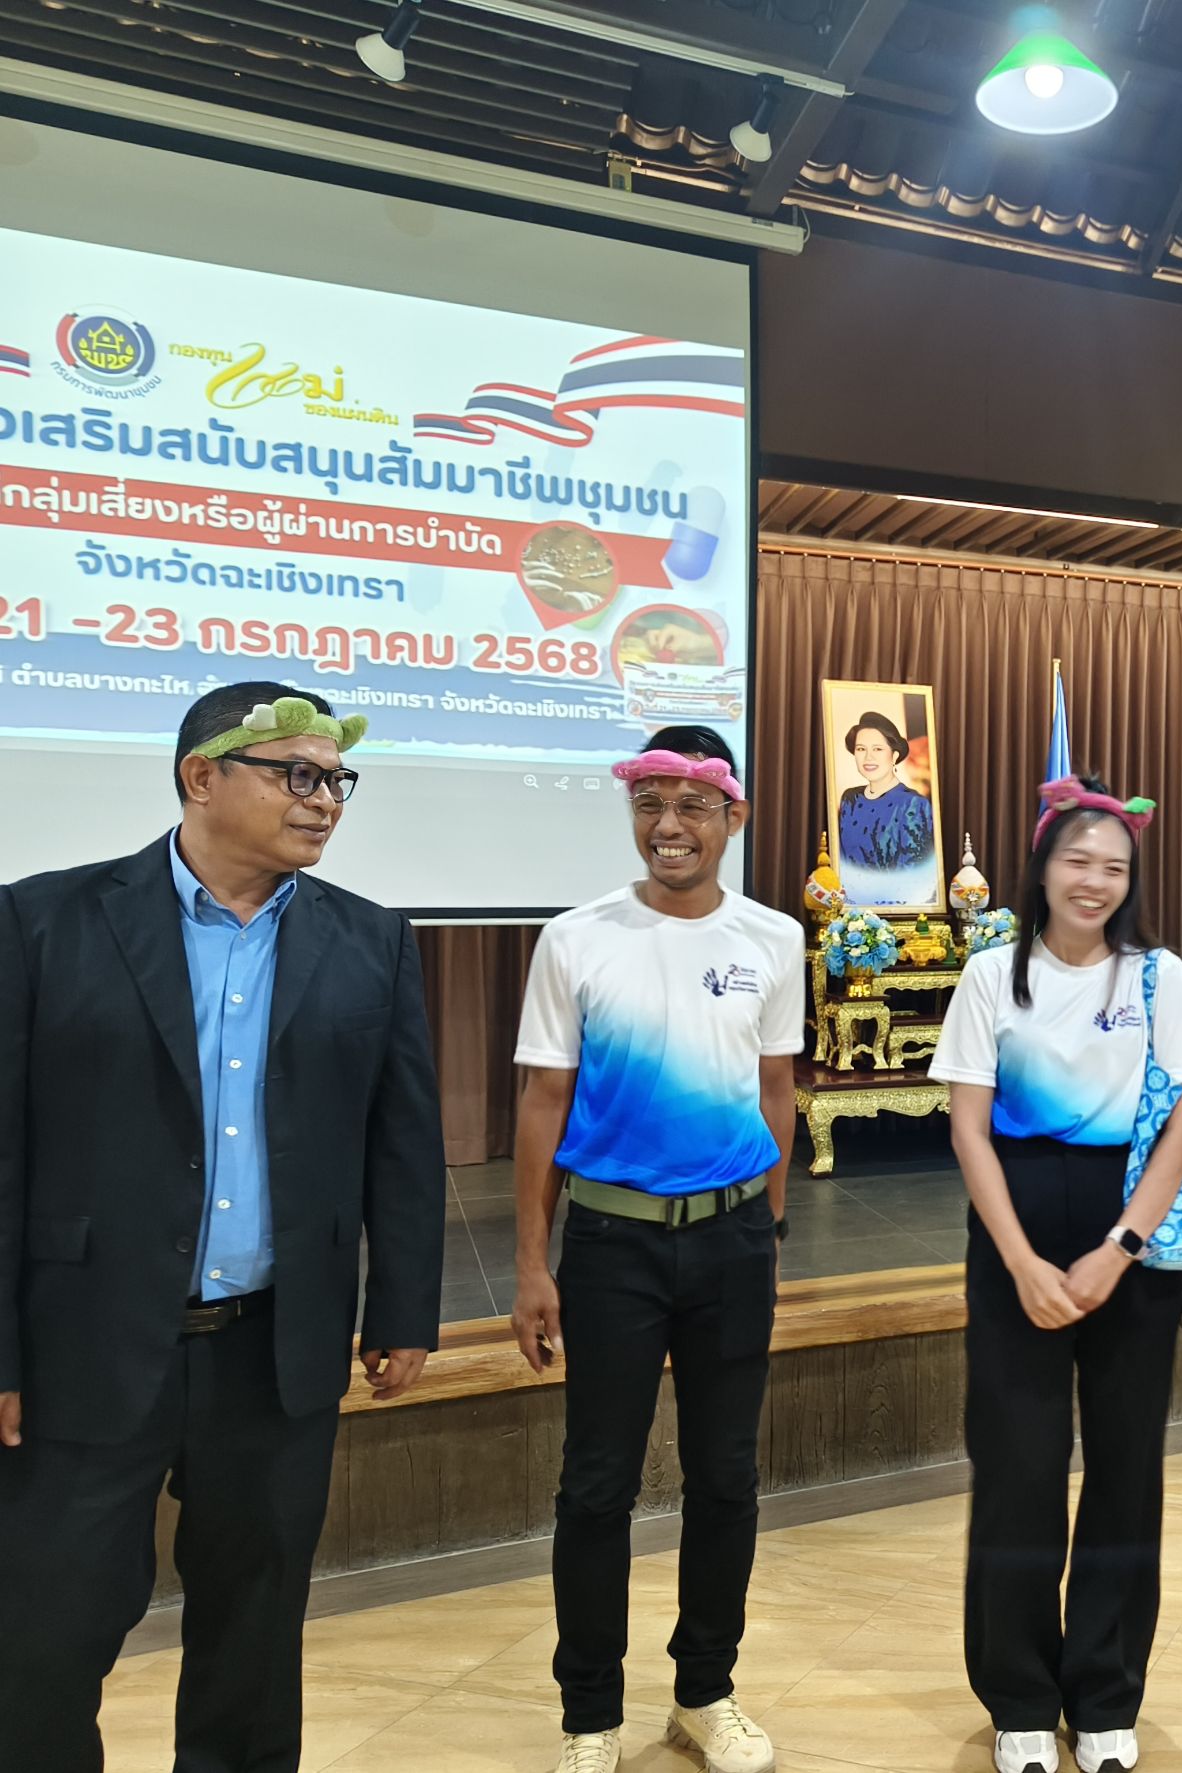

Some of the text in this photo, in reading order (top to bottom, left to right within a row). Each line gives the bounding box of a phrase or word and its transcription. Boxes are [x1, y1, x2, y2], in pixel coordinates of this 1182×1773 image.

[168, 343, 233, 367] กองทุน
[1, 475, 503, 557] กลุ่มเสี่ยงหรือผู้ผ่านการบำบัด
[75, 539, 405, 602] จังหวัดฉะเชิงเทรา
[199, 616, 455, 672] กรกฎาคม
[473, 633, 599, 677] 2568
[440, 690, 612, 720] จังหวัดฉะเชิงเทรา
